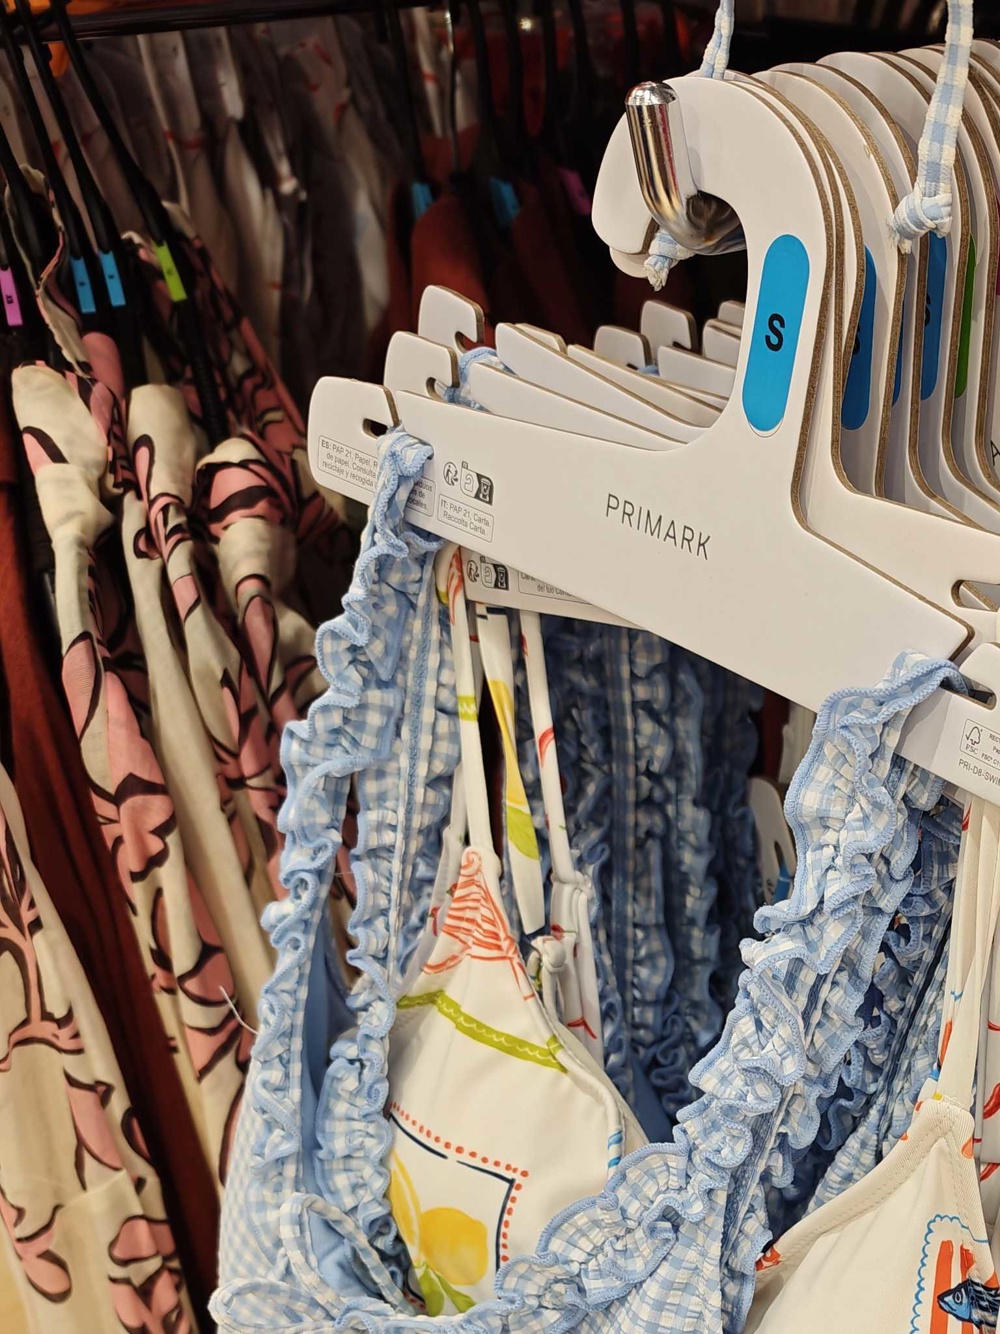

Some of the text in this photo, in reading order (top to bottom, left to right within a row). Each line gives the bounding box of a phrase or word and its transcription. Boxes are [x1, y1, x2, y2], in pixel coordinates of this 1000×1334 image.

[765, 313, 785, 351] S
[321, 439, 331, 450] ES:
[332, 443, 344, 454] PAP
[326, 452, 333, 461] de
[441, 499, 449, 509] IT:
[450, 502, 462, 514] PAP
[443, 510, 468, 528] Raccolta
[606, 493, 711, 561] PRIMARK
[965, 743, 978, 754] FSC
